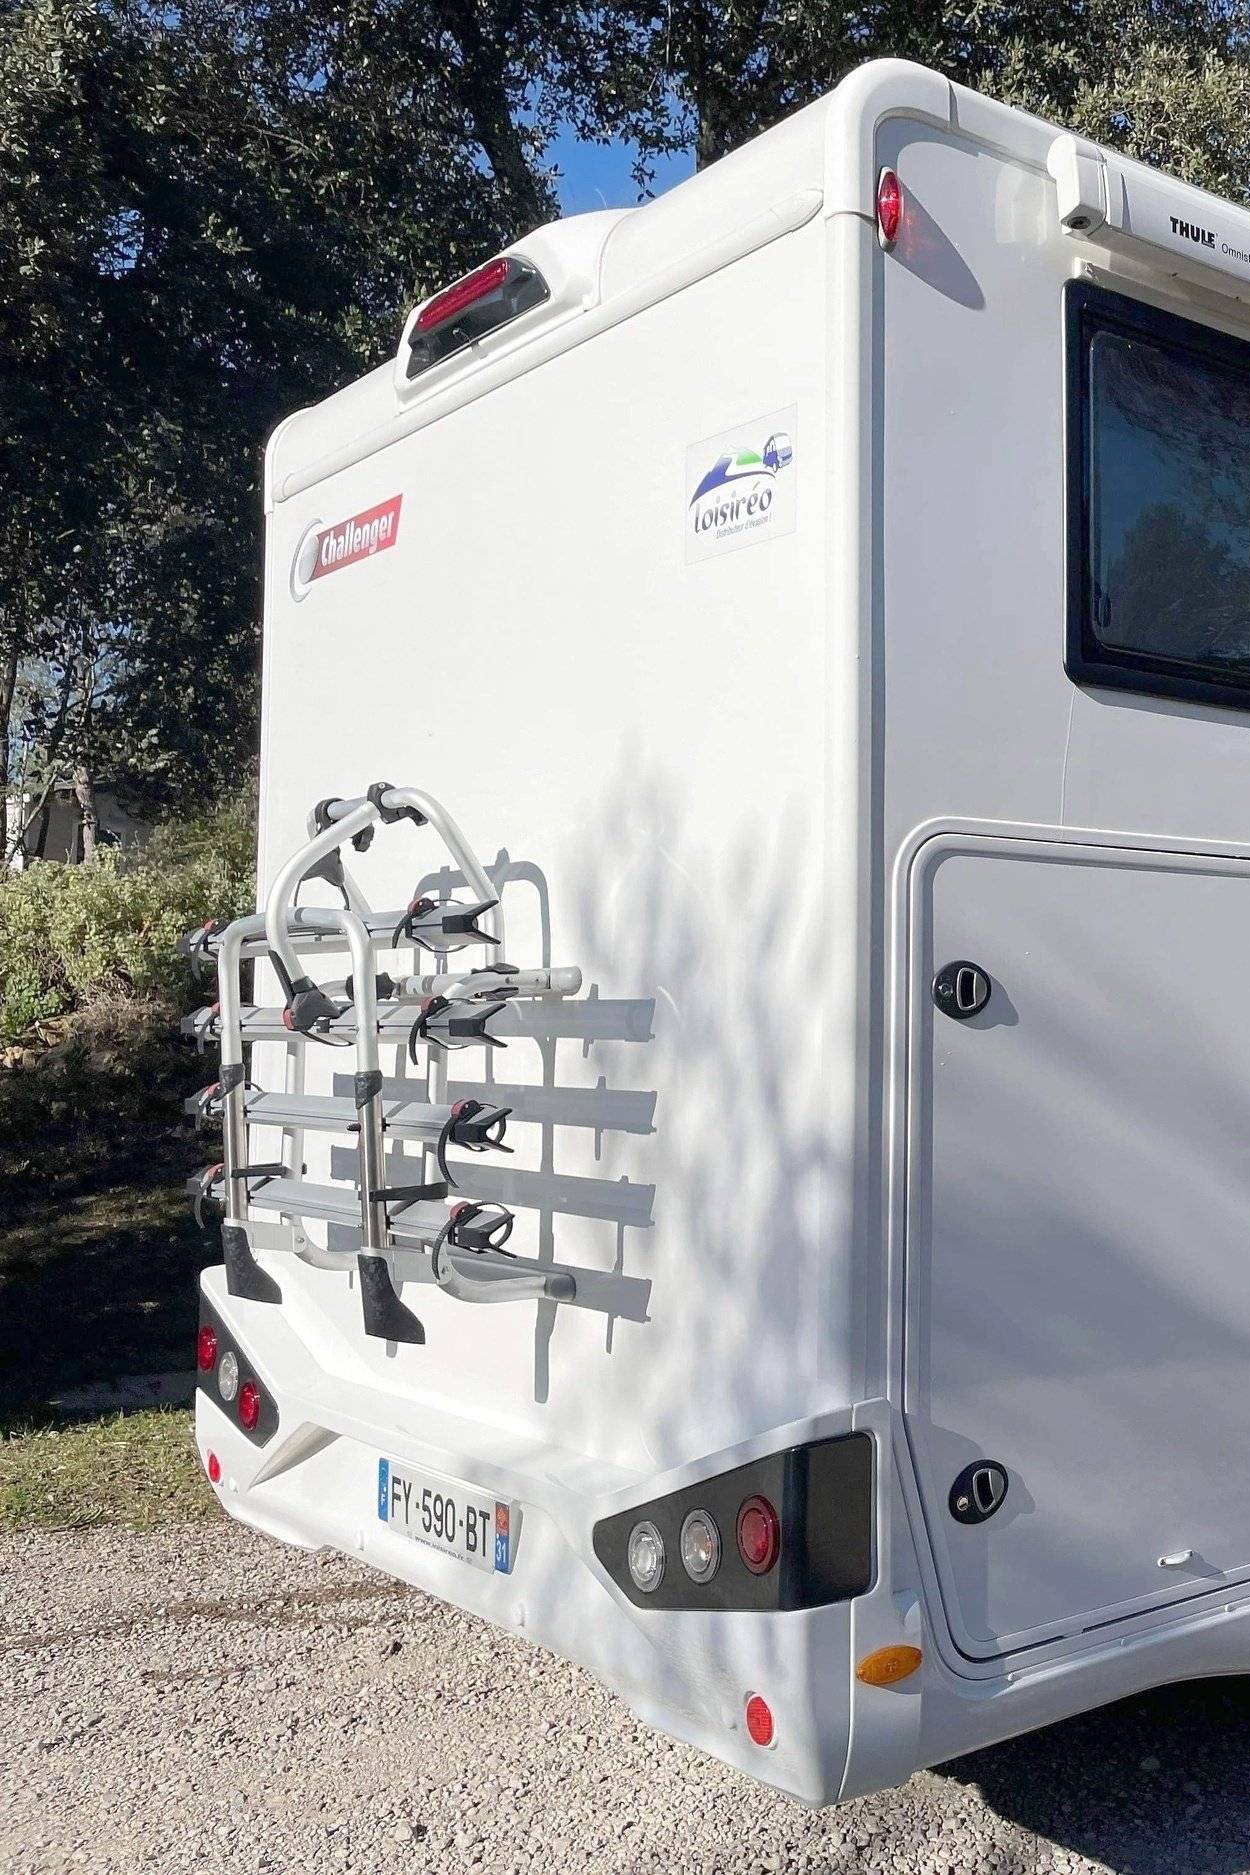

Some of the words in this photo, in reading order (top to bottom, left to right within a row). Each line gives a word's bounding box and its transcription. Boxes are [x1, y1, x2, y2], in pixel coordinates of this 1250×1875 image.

[1169, 215, 1216, 249] THULE
[321, 511, 395, 567] Challenger
[391, 1475, 491, 1558] FY-590-BT
[495, 1540, 507, 1564] 31
